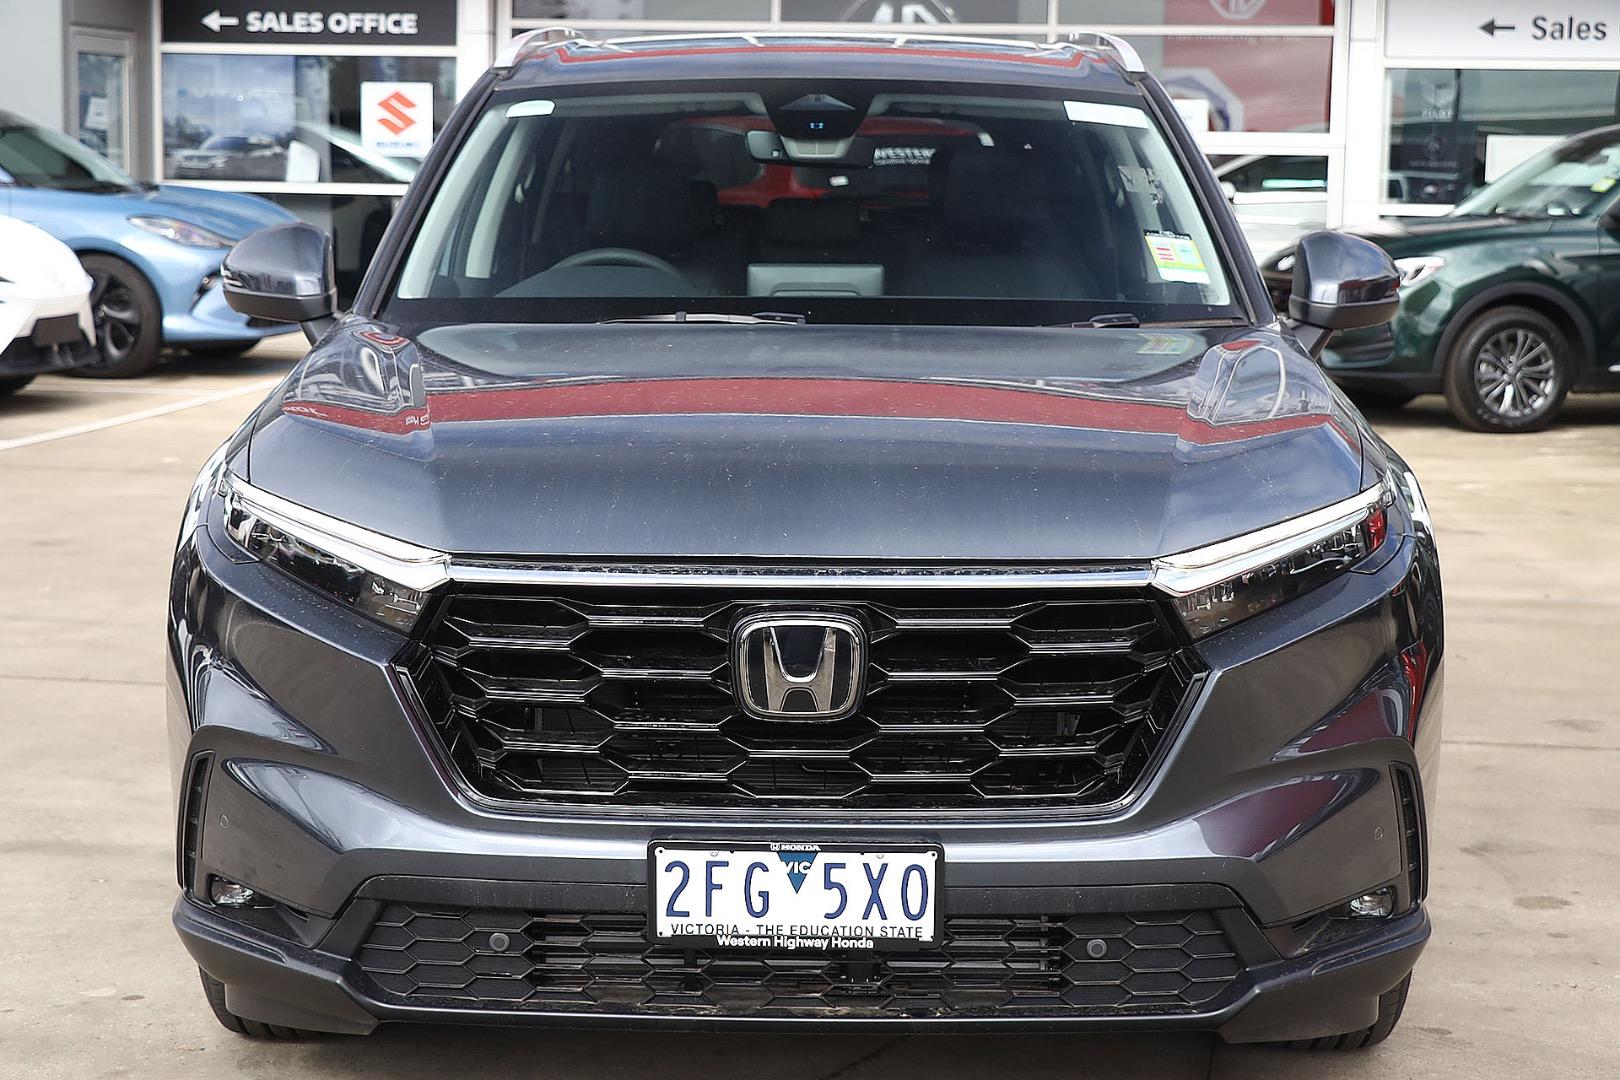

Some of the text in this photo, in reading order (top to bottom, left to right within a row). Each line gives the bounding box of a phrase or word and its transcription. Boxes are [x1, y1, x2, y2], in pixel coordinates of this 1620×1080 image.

[246, 11, 418, 34] SALES OFFICE
[1531, 15, 1607, 41] Sales
[781, 861, 813, 874] VIC
[664, 860, 770, 919] 2FG
[671, 923, 739, 935] VICTORIA
[756, 924, 784, 936] THE
[790, 925, 874, 937] EDUCATION
[880, 926, 923, 938] STATE
[716, 935, 874, 950] Western Highway Honda
